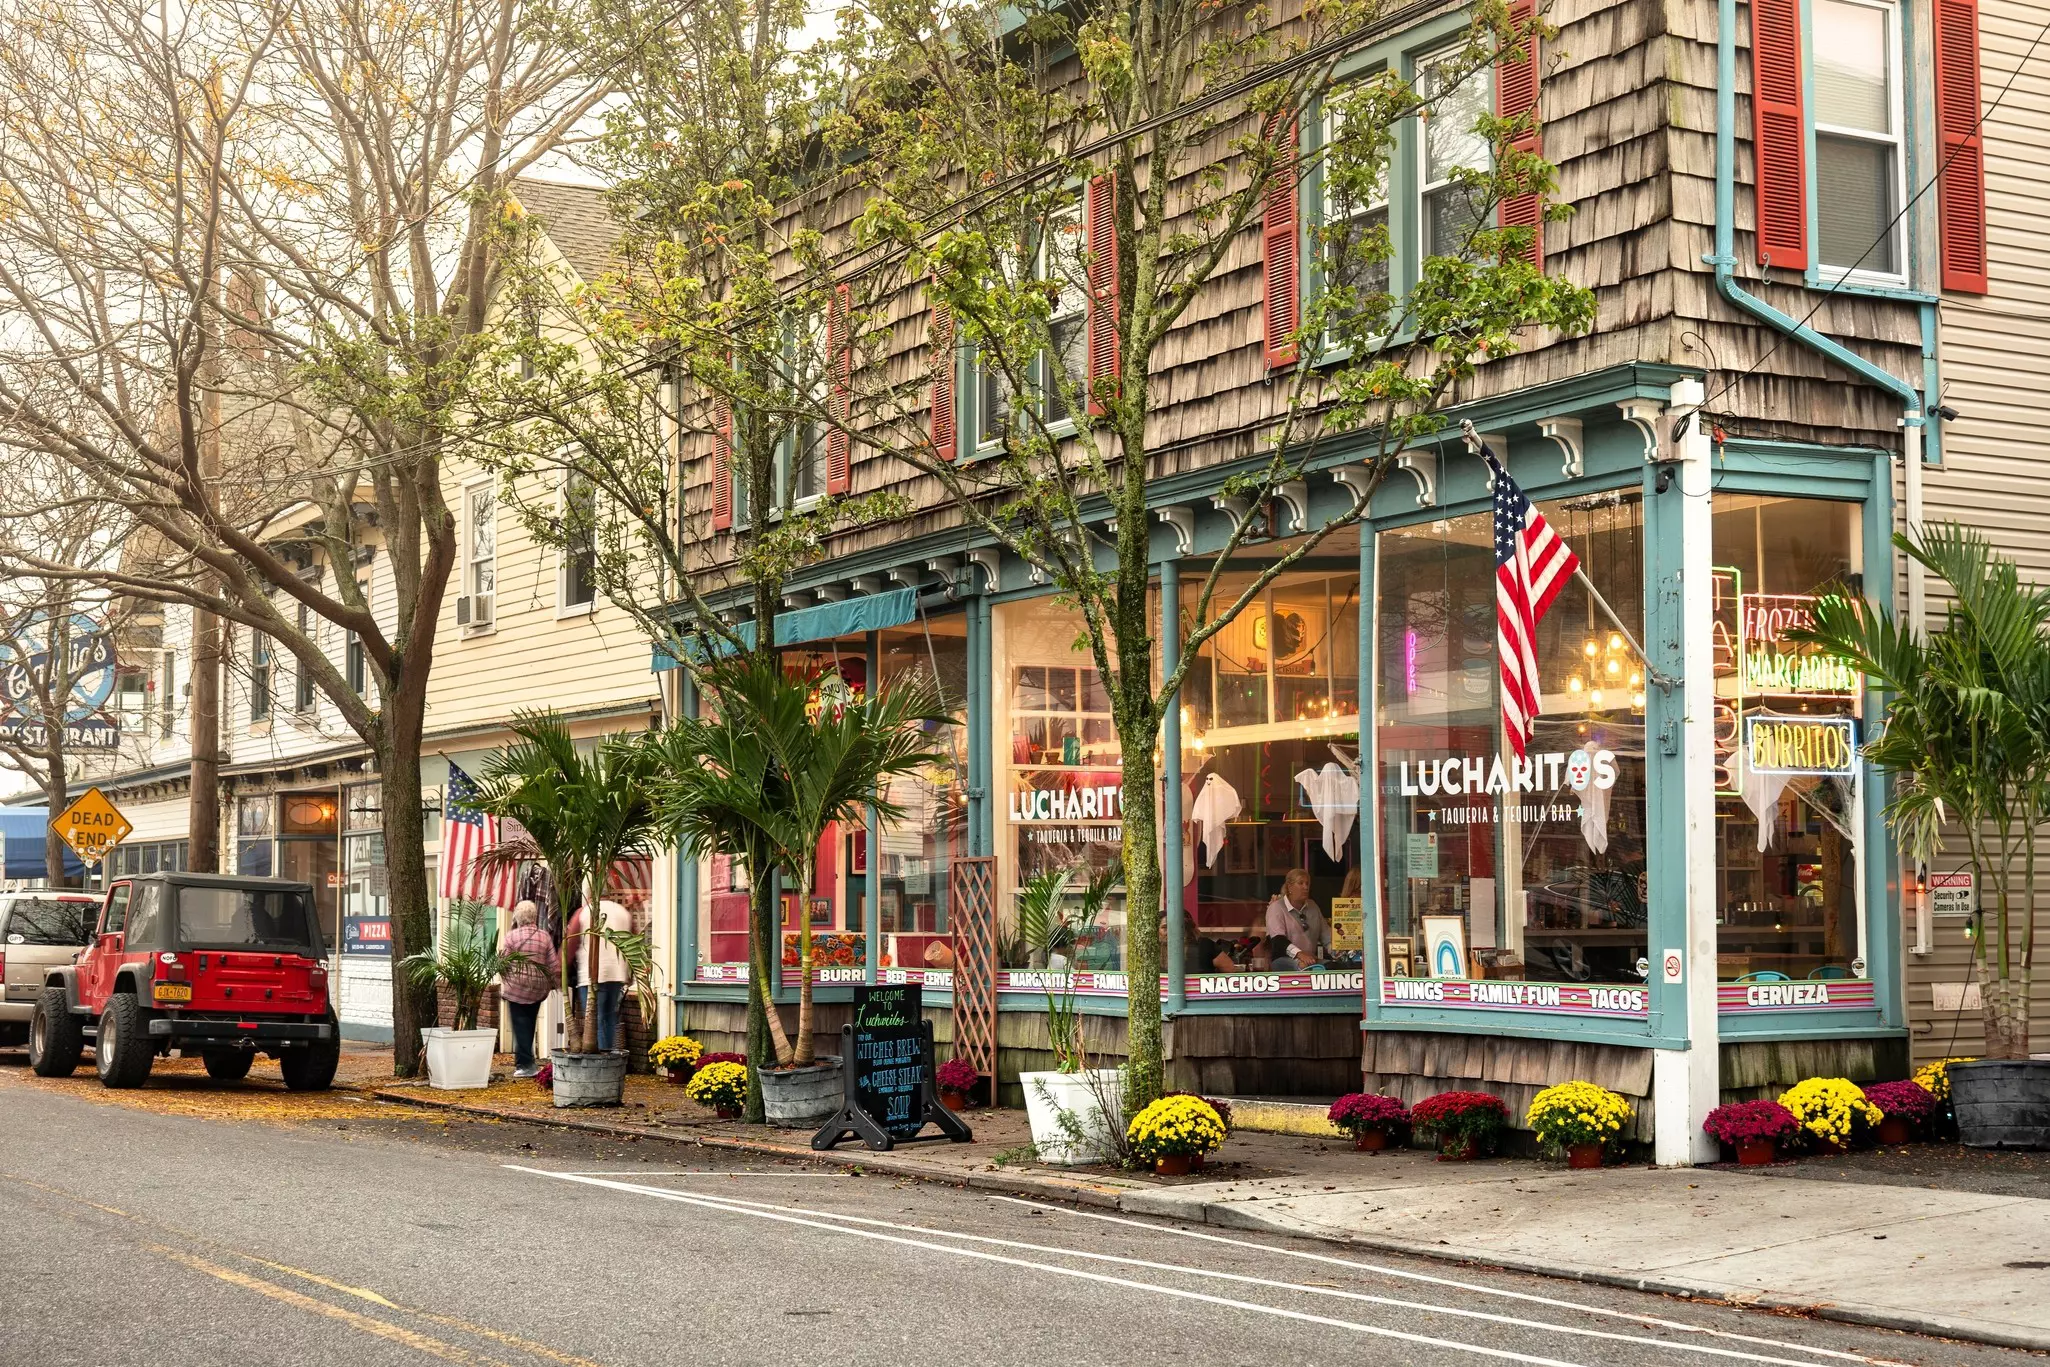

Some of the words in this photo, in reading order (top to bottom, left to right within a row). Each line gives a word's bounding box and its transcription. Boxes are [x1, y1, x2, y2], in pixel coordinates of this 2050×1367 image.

[1753, 723, 1850, 769] BURRITOS
[72, 812, 114, 826] DEAD
[1442, 808, 1488, 824] TAQUERIA
[1493, 807, 1499, 823] &
[1504, 805, 1547, 823] TEQUILA
[1552, 804, 1572, 821] BAR
[76, 832, 107, 846] END
[1036, 830, 1067, 844] TAQUERIA
[1070, 830, 1075, 843] &
[1077, 828, 1105, 843] TEQUILA
[1108, 827, 1122, 841] BAR
[1932, 876, 1970, 886] WARNING
[1934, 890, 1955, 901] Security
[1934, 902, 1954, 911] Cameras
[1961, 902, 1970, 911] Use
[364, 924, 387, 938] PIZZA
[703, 966, 723, 979] TACOS
[820, 969, 866, 982] BURRI
[886, 970, 907, 983] BEER
[1009, 972, 1074, 988] MARGARITAS
[1200, 976, 1280, 993] NACHOS
[1310, 973, 1363, 990] WING
[868, 989, 905, 1002] WELCOME
[1394, 981, 1444, 1001] WINGS
[1469, 983, 1524, 1004] FAMILY
[1527, 986, 1560, 1006] FUN
[1588, 988, 1643, 1011] TACOS
[1747, 984, 1829, 1006] CERVEZA
[882, 1001, 892, 1010] TO
[857, 1040, 894, 1060] WITCHES
[872, 1069, 897, 1087] CHEESE
[898, 1065, 922, 1086] STEAK
[887, 1095, 911, 1116] SOUP
